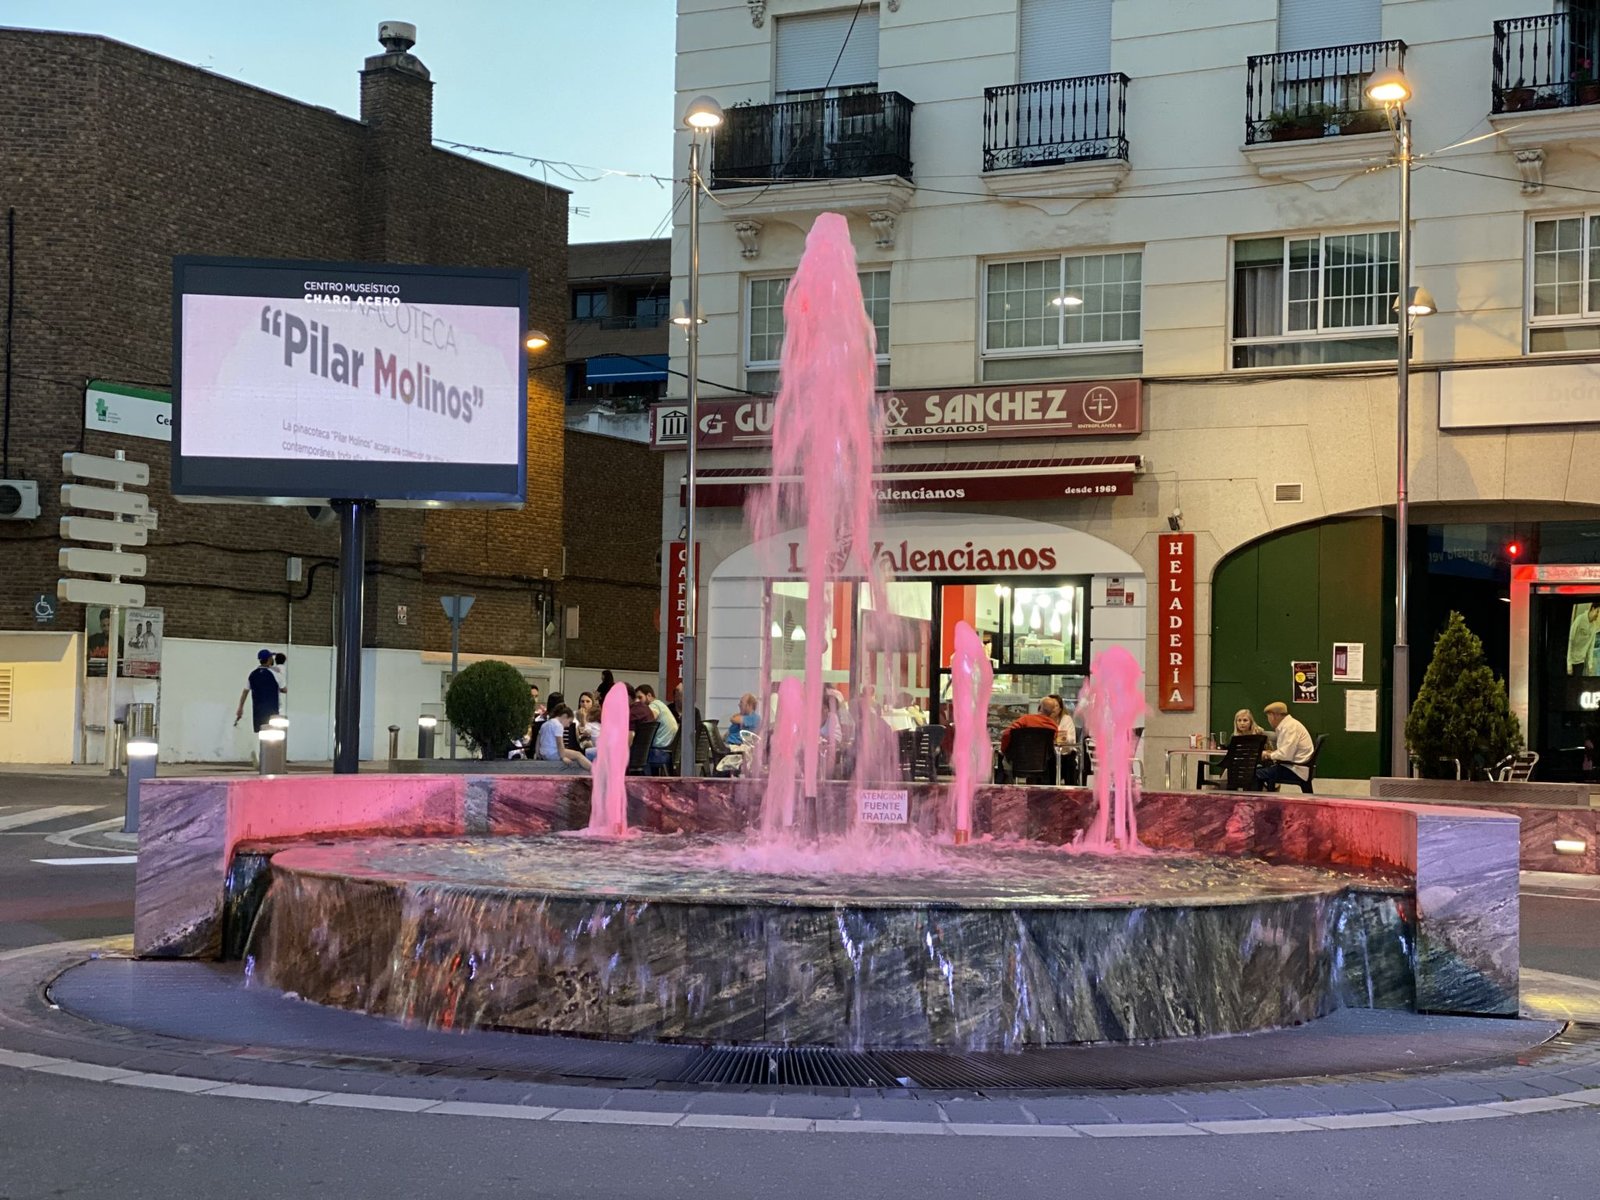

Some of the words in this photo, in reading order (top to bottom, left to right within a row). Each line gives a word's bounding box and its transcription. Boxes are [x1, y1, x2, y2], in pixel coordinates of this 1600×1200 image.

[304, 281, 343, 292] CENTRO
[345, 282, 400, 294] MUSEÍSTICO
[304, 293, 350, 305] CHARO
[356, 296, 400, 307] ACERO
[925, 389, 1068, 424] SANCHEZ
[282, 419, 291, 432] La
[904, 424, 985, 435] ABOGADOS
[1065, 485, 1092, 495] desde
[1095, 484, 1117, 494] 1969
[1169, 542, 1183, 702] HELADERÍA
[864, 802, 900, 811] FUENTE
[862, 812, 903, 821] TRATADA
